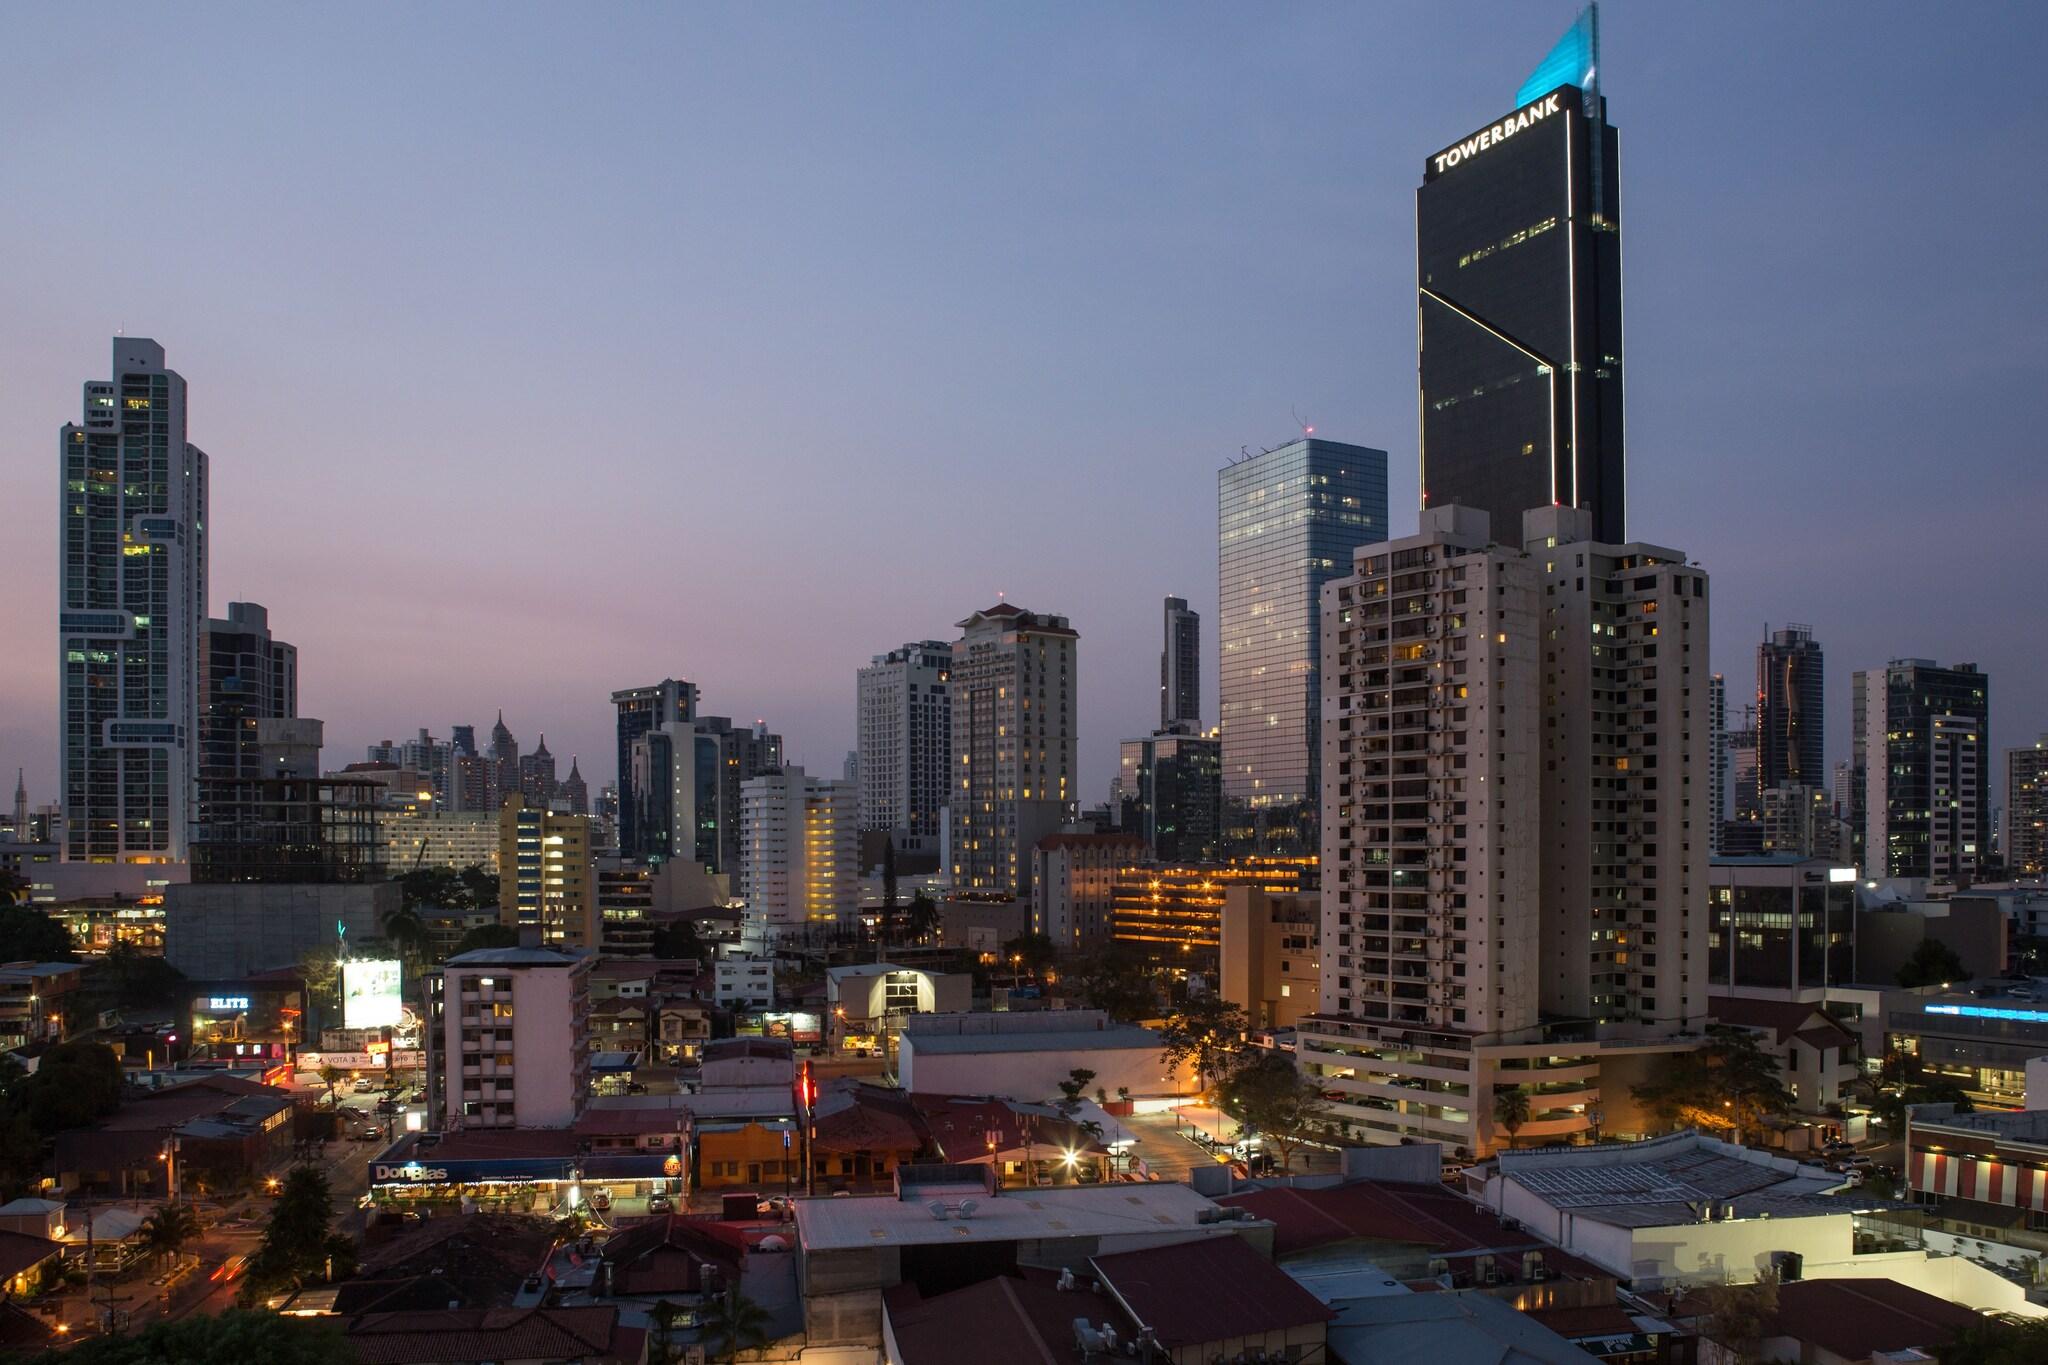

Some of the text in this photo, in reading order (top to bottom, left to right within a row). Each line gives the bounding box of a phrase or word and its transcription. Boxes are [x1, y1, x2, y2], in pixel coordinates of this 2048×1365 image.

[1435, 93, 1560, 173] TOWERBANK
[210, 998, 249, 1009] ELITE
[328, 1056, 349, 1064] VOTA
